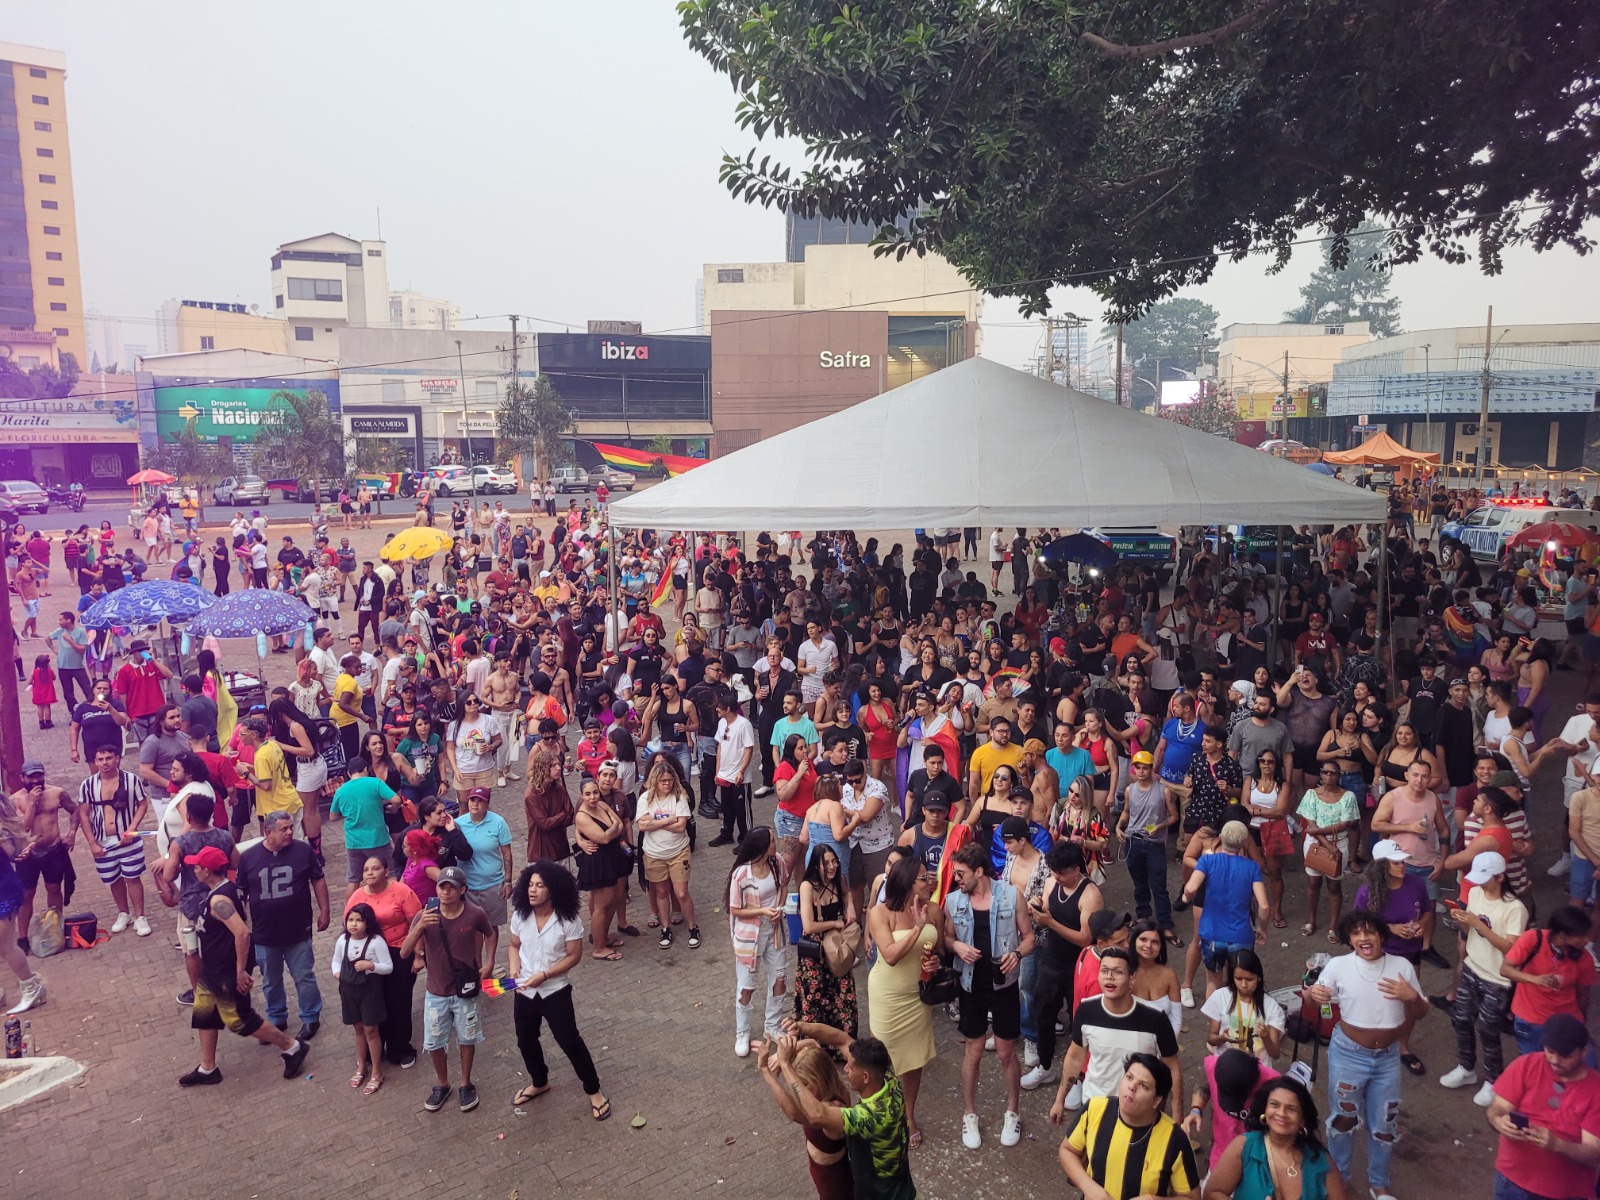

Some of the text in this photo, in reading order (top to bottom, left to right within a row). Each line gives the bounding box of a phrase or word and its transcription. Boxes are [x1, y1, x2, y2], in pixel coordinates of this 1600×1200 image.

[601, 340, 649, 360] ibiza
[820, 350, 871, 368] Safra
[211, 400, 247, 408] Drogarias
[353, 420, 377, 428] CAMILA
[258, 865, 293, 900] 12
